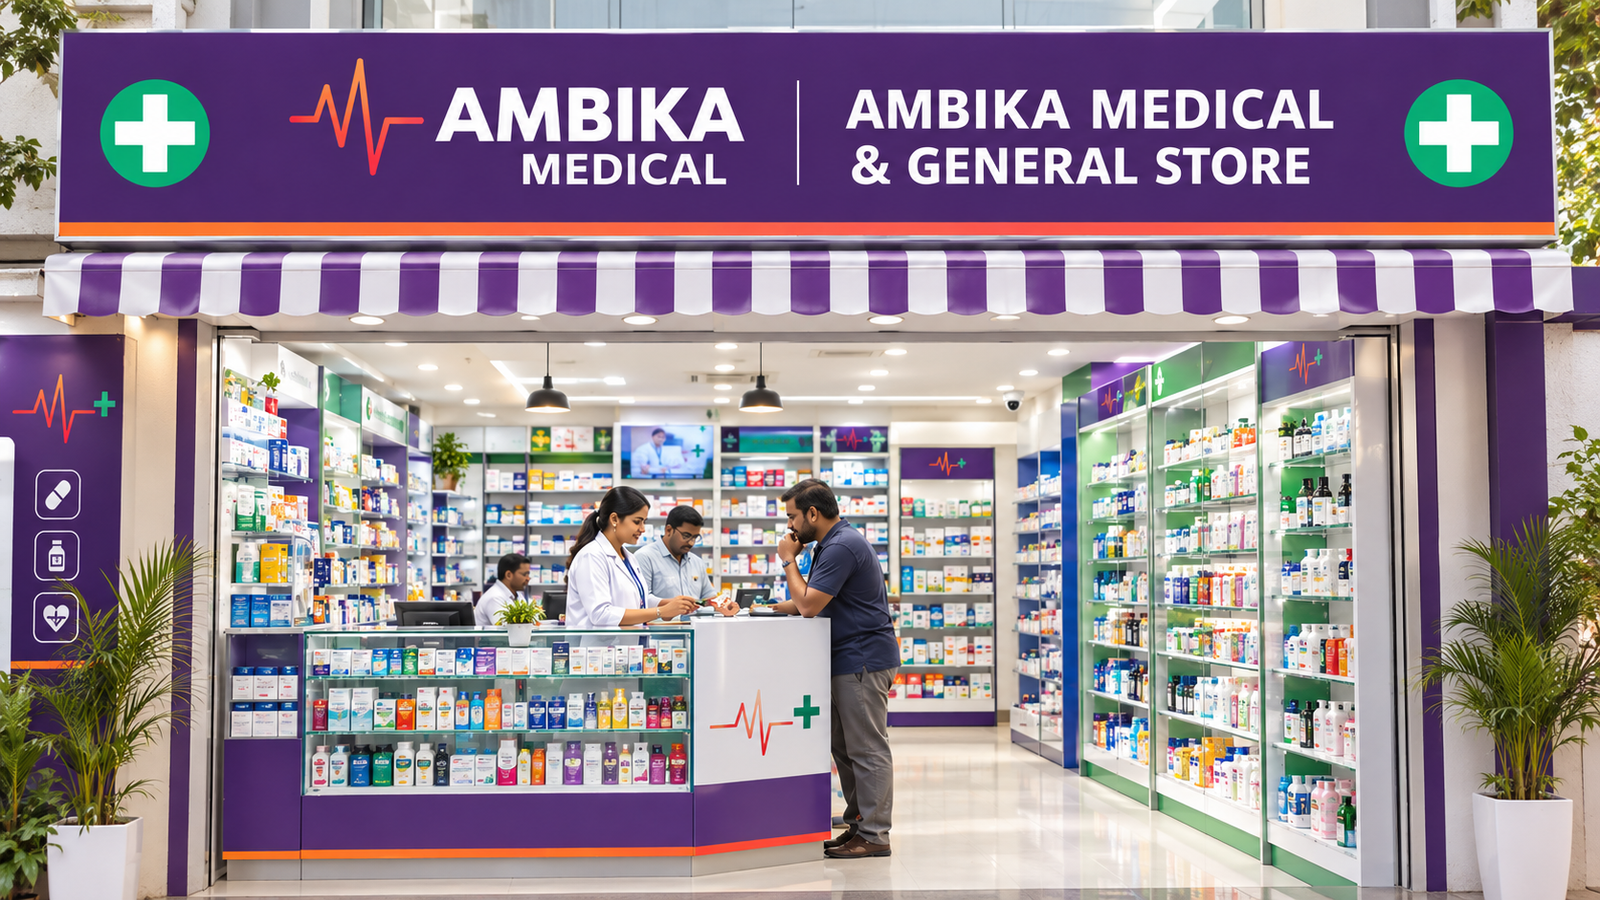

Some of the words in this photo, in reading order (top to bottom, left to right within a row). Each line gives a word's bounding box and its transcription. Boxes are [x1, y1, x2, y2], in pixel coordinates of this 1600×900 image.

[436, 87, 745, 142] AMBIKA
[845, 89, 1071, 130] AMBIKA
[1092, 88, 1334, 130] MEDICAL
[522, 152, 727, 186] MEDICAL
[851, 144, 891, 185] &
[908, 146, 1138, 185] GENERAL
[1155, 146, 1310, 185] STORE
